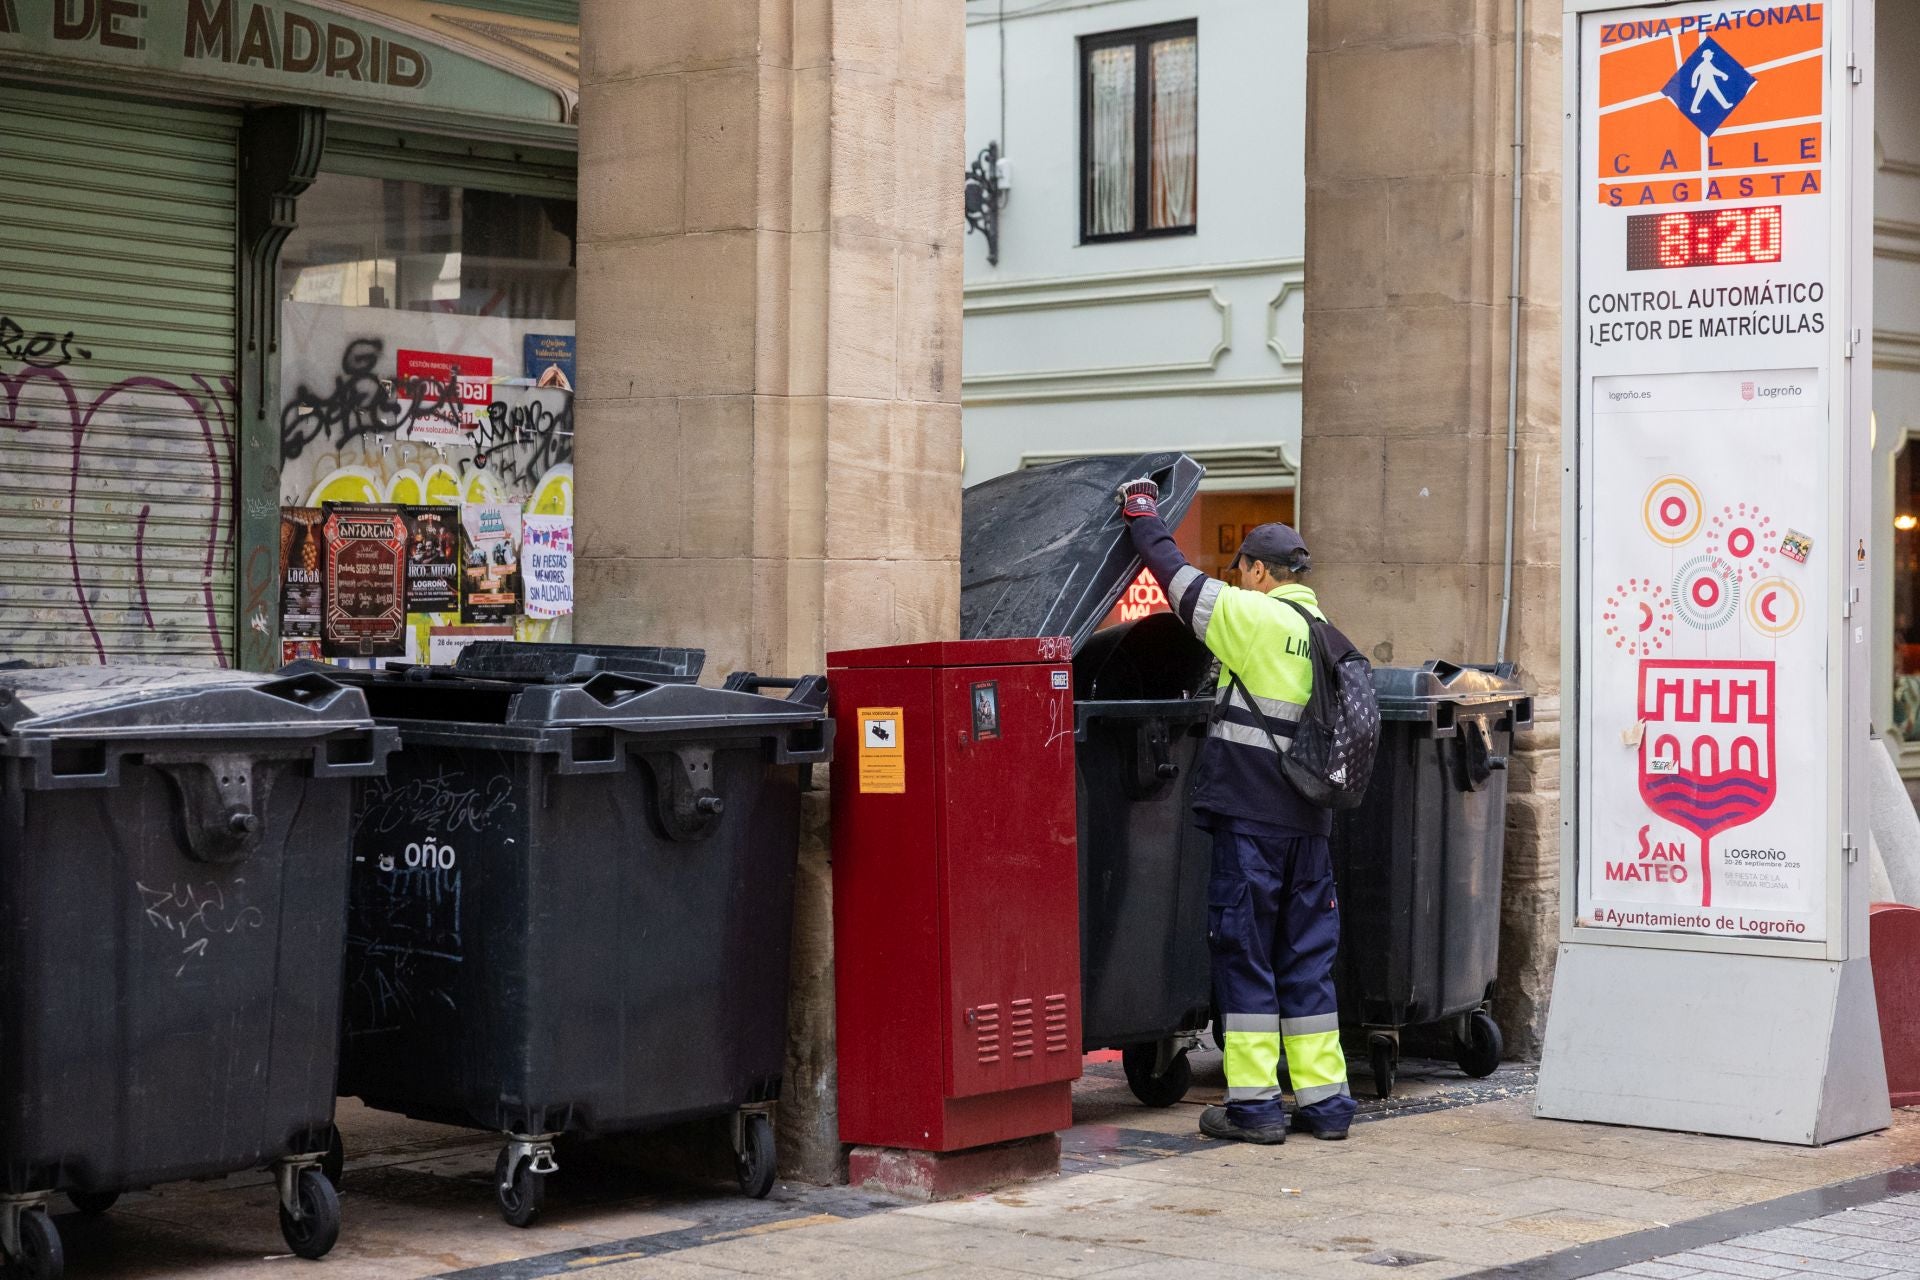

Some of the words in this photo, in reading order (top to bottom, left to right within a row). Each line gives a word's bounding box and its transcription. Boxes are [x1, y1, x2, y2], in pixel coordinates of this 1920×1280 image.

[1601, 19, 1672, 44] ZONA
[1680, 3, 1821, 35] PEATONAL
[54, 0, 146, 50] DE
[184, 0, 431, 88] MADRID
[1613, 137, 1817, 175] CALLE
[1609, 173, 1819, 207] SAGASTA
[1659, 207, 1780, 267] 8:20
[1588, 290, 1682, 314] CONTROL
[1688, 279, 1824, 309] AUTOMÁTICO
[1589, 320, 1662, 347] LECTOR
[1668, 319, 1692, 339] DE
[1699, 310, 1825, 339] MATRÍCULAS
[1609, 390, 1652, 402] logroño.es
[1757, 384, 1802, 399] Logroño
[340, 524, 394, 538] ANTORCHA
[533, 554, 541, 567] EN
[543, 554, 567, 569] FIESTAS
[287, 567, 323, 583] LOGROÑ
[534, 569, 565, 583] MENORES
[412, 579, 447, 588] LOGROÑO
[529, 586, 540, 601] SIN
[541, 585, 573, 602] ALCOHOL
[437, 638, 445, 646] 28
[1638, 824, 1685, 862] SAN
[1724, 848, 1786, 861] LOGROÑO
[1744, 860, 1782, 868] septiembre
[1605, 861, 1688, 884] MATEO
[1735, 872, 1758, 880] FIESTA
[1725, 879, 1757, 888] VENDIMIA
[1759, 881, 1789, 890] RIOJANA
[1606, 908, 1711, 927] Ayuntamiento
[1715, 914, 1735, 930] de
[1739, 916, 1806, 935] Logroño
